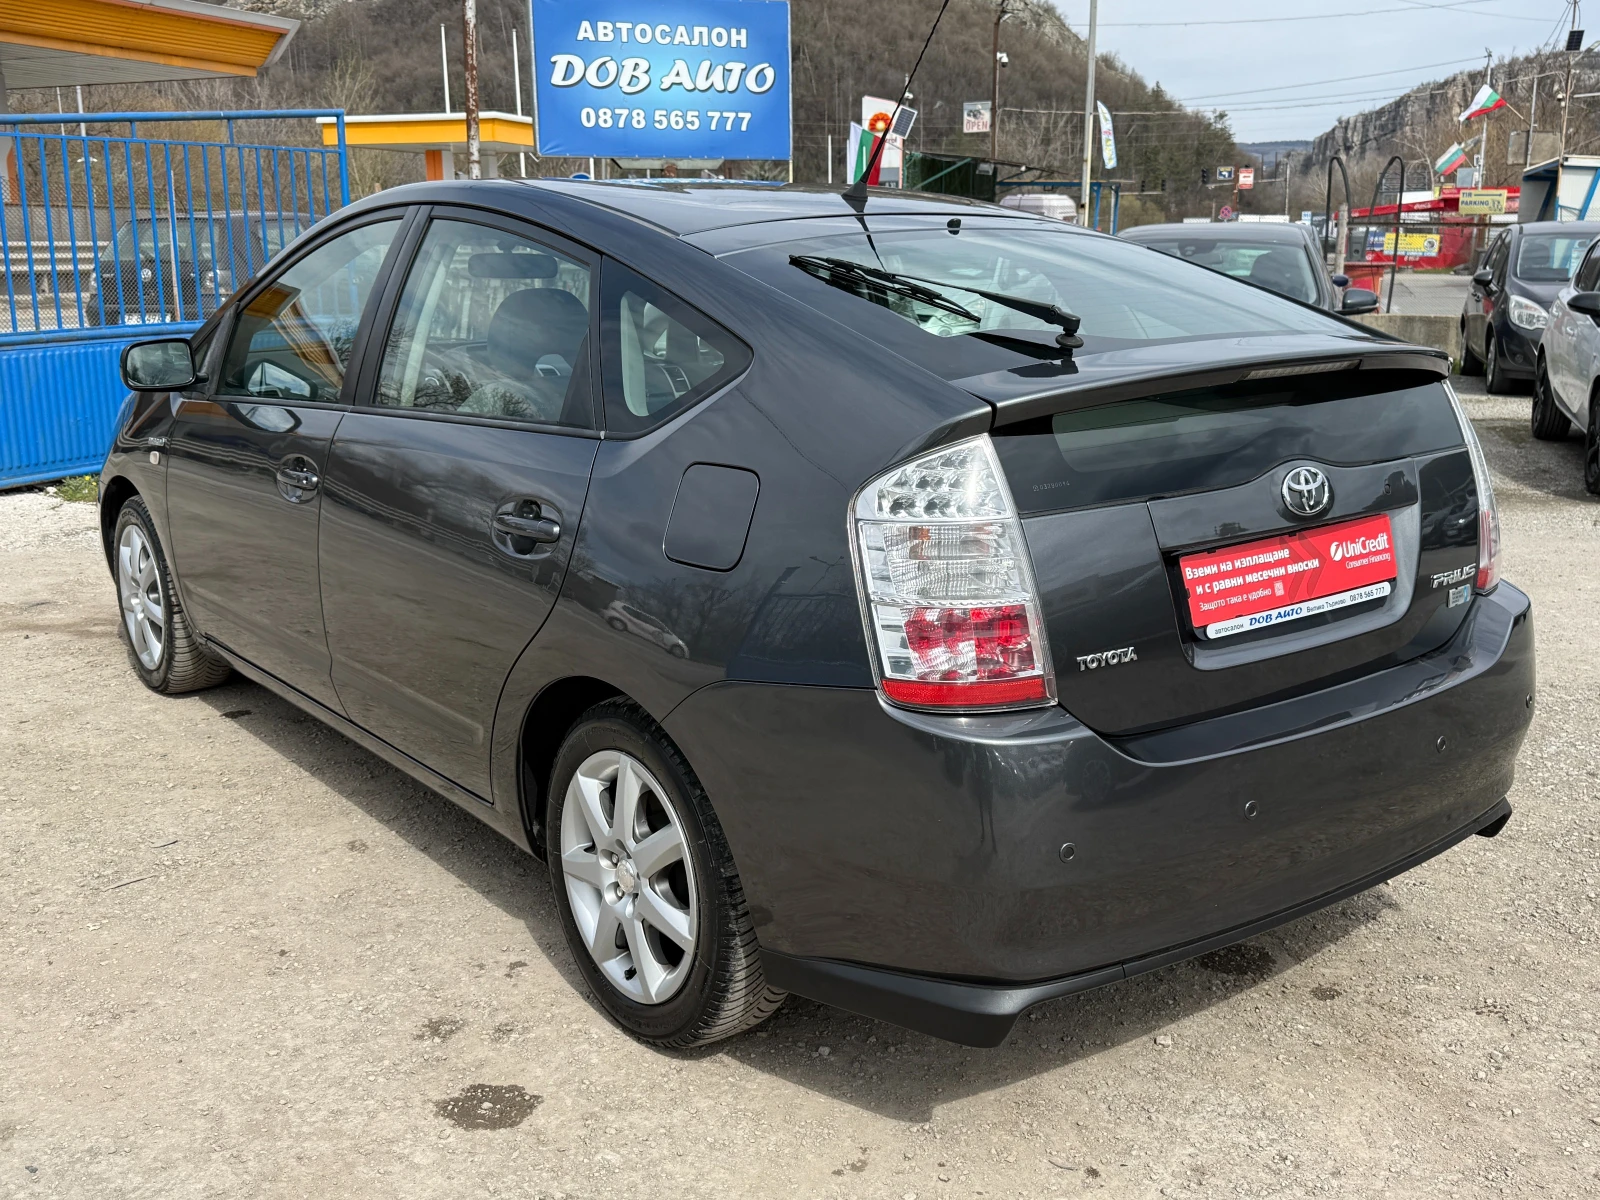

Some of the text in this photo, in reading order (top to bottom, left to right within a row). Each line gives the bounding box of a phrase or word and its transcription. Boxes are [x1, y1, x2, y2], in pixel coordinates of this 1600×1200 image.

[576, 20, 748, 48] АВТОСАЛОН
[550, 54, 775, 94] DOB AUTO
[580, 107, 752, 132] 0878 565 777
[966, 120, 988, 130] OPEN
[1342, 532, 1390, 558] UniCredit
[1185, 548, 1290, 580] Вземи на изплащане
[1346, 552, 1390, 569] Consumer Financing
[1196, 558, 1319, 595] и с равни месечни вноски
[1431, 563, 1476, 588] PRIUS
[1199, 588, 1272, 612] Защото така е удобно
[1214, 623, 1244, 634] автосалон
[1249, 614, 1272, 626] DOB
[1274, 607, 1302, 620] AUTO
[1349, 592, 1363, 602] 0878
[1364, 590, 1374, 598] 565
[1375, 587, 1385, 595] 777
[1076, 646, 1138, 671] TOYOTA
